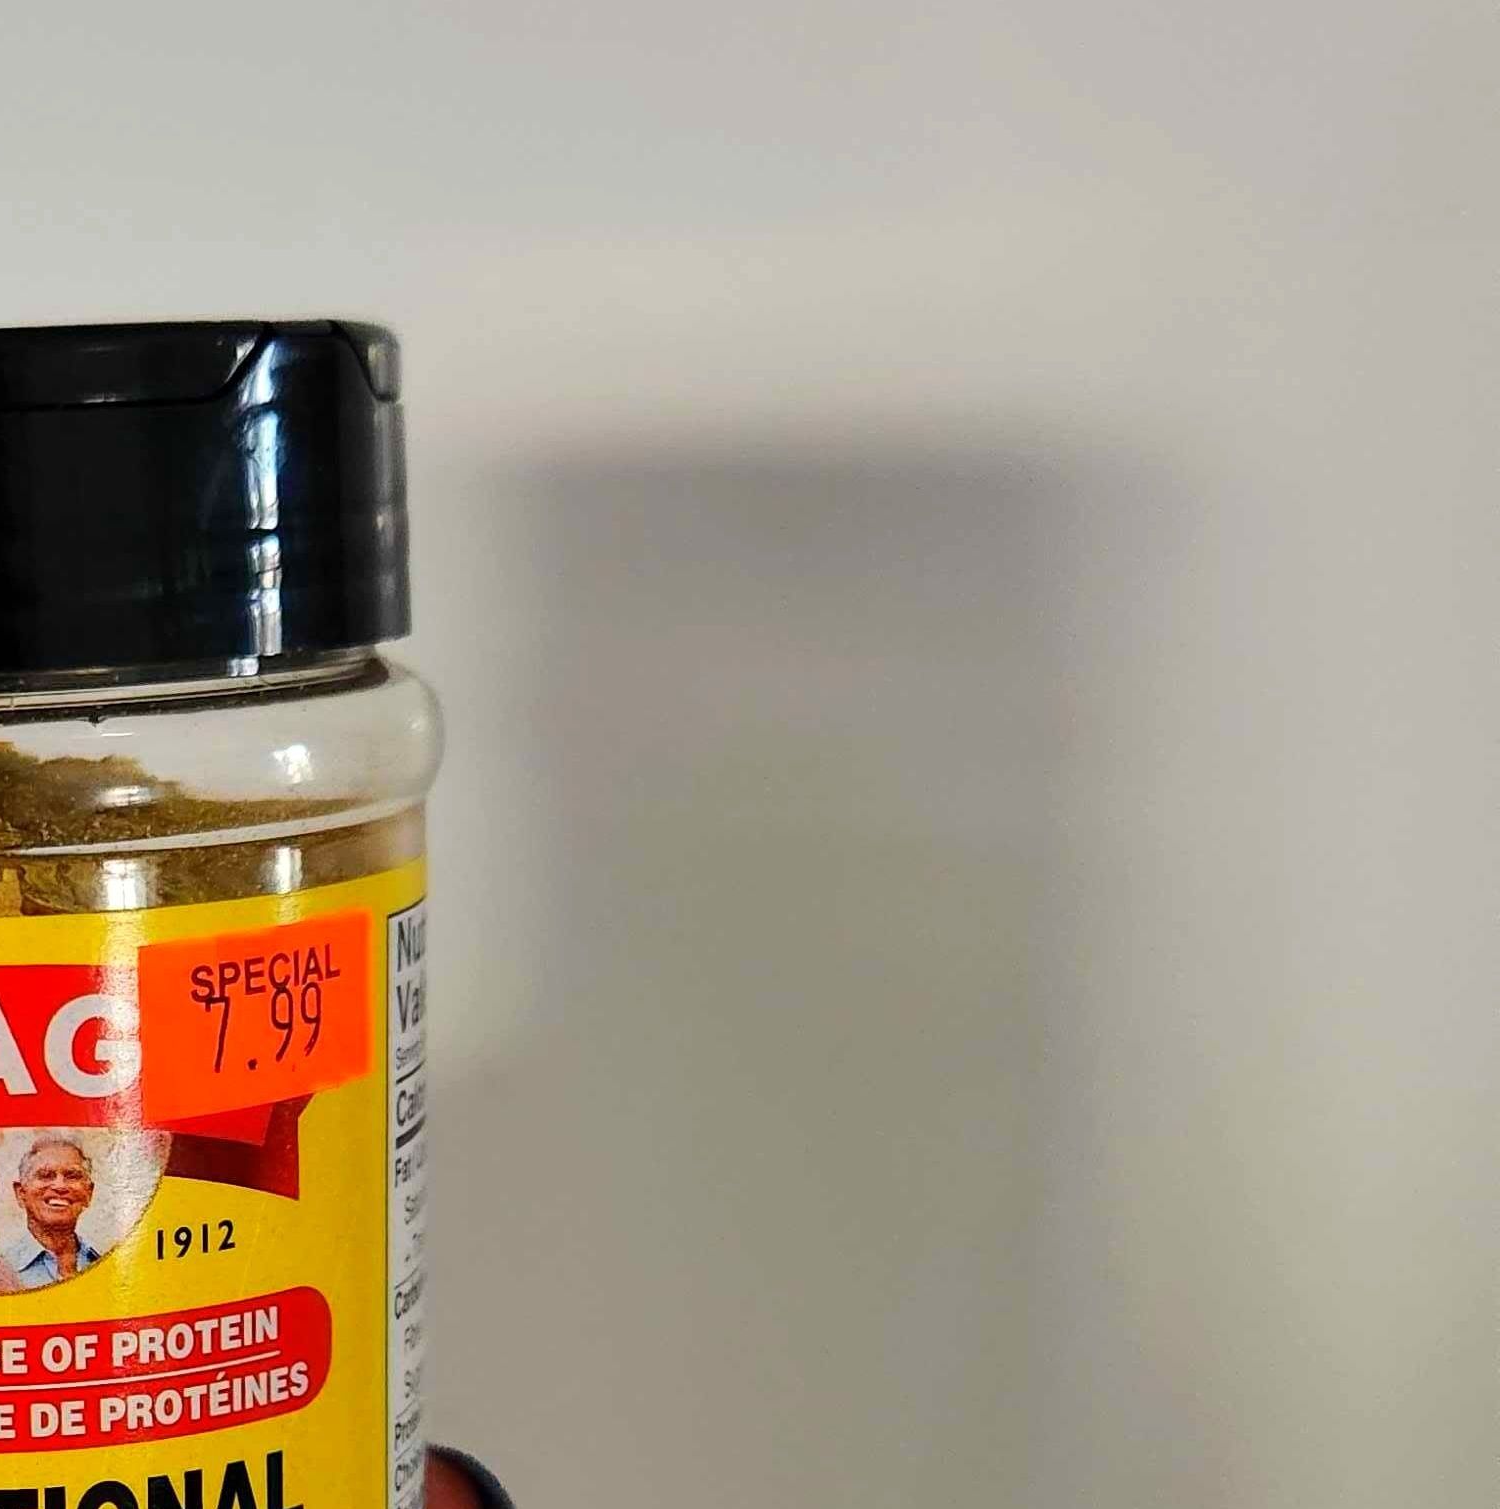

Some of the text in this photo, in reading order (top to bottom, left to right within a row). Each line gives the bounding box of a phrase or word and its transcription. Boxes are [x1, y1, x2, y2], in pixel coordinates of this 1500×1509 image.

[190, 943, 341, 1003] SPECIAL
[204, 981, 322, 1074] 7.99
[155, 1218, 236, 1261] 1912
[40, 1333, 99, 1374] OF
[111, 1305, 279, 1368] PROTEIN
[29, 1400, 86, 1439] DE
[99, 1361, 309, 1433] PROTÉINES
